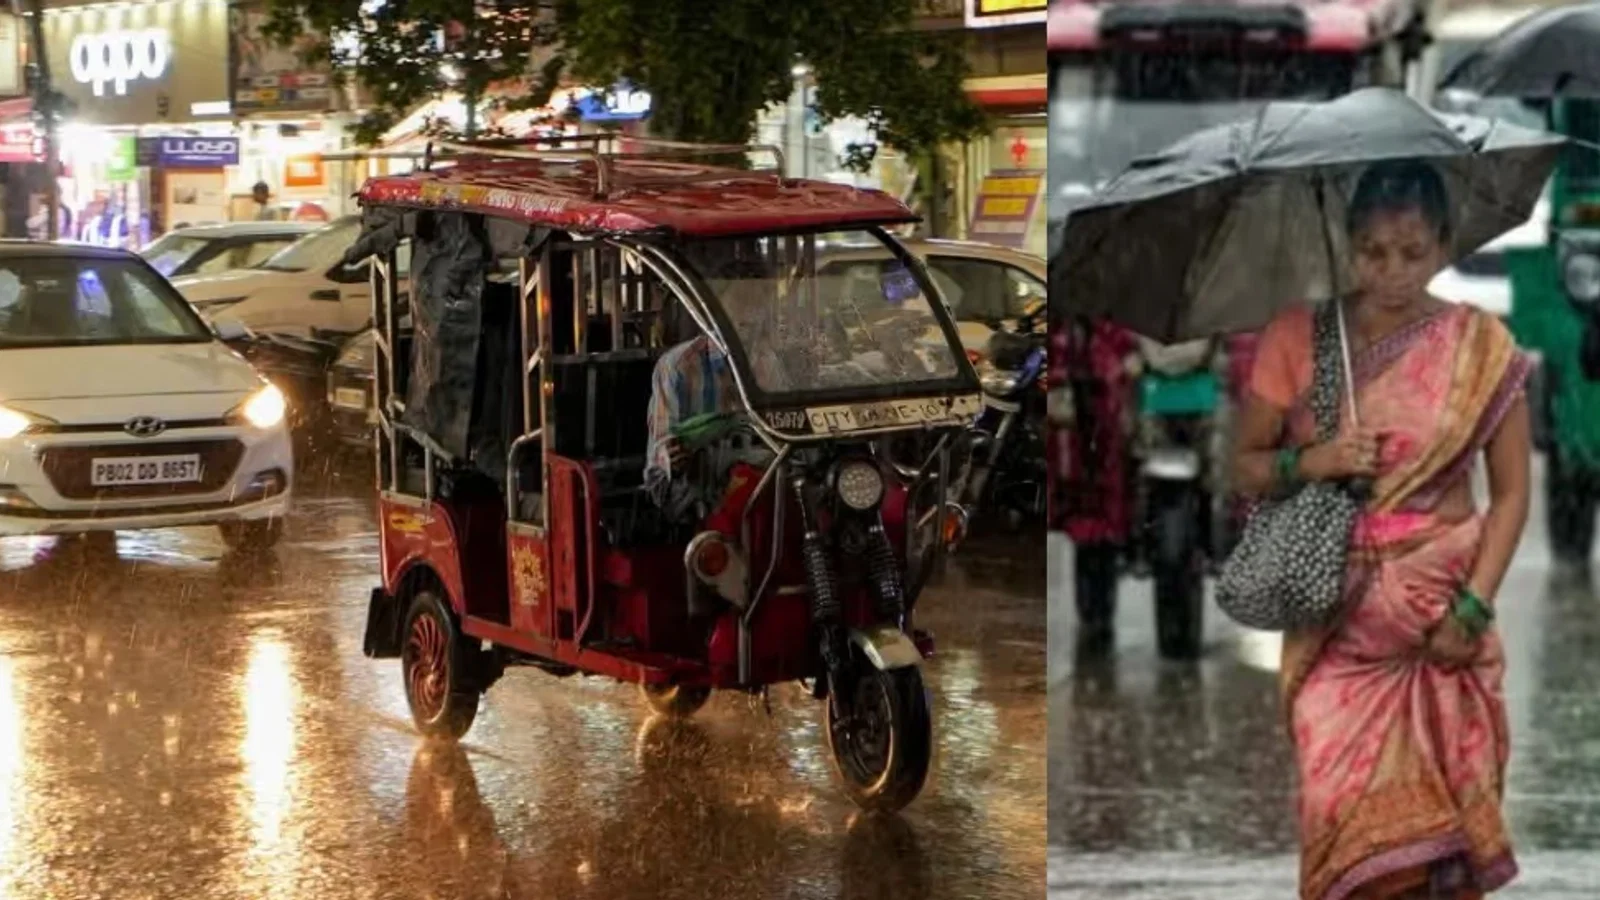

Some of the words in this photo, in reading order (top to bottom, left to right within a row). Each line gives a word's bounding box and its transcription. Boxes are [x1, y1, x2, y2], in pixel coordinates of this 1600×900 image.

[71, 28, 168, 96] oppo
[163, 140, 237, 155] LLOYD
[811, 409, 851, 428] CITY
